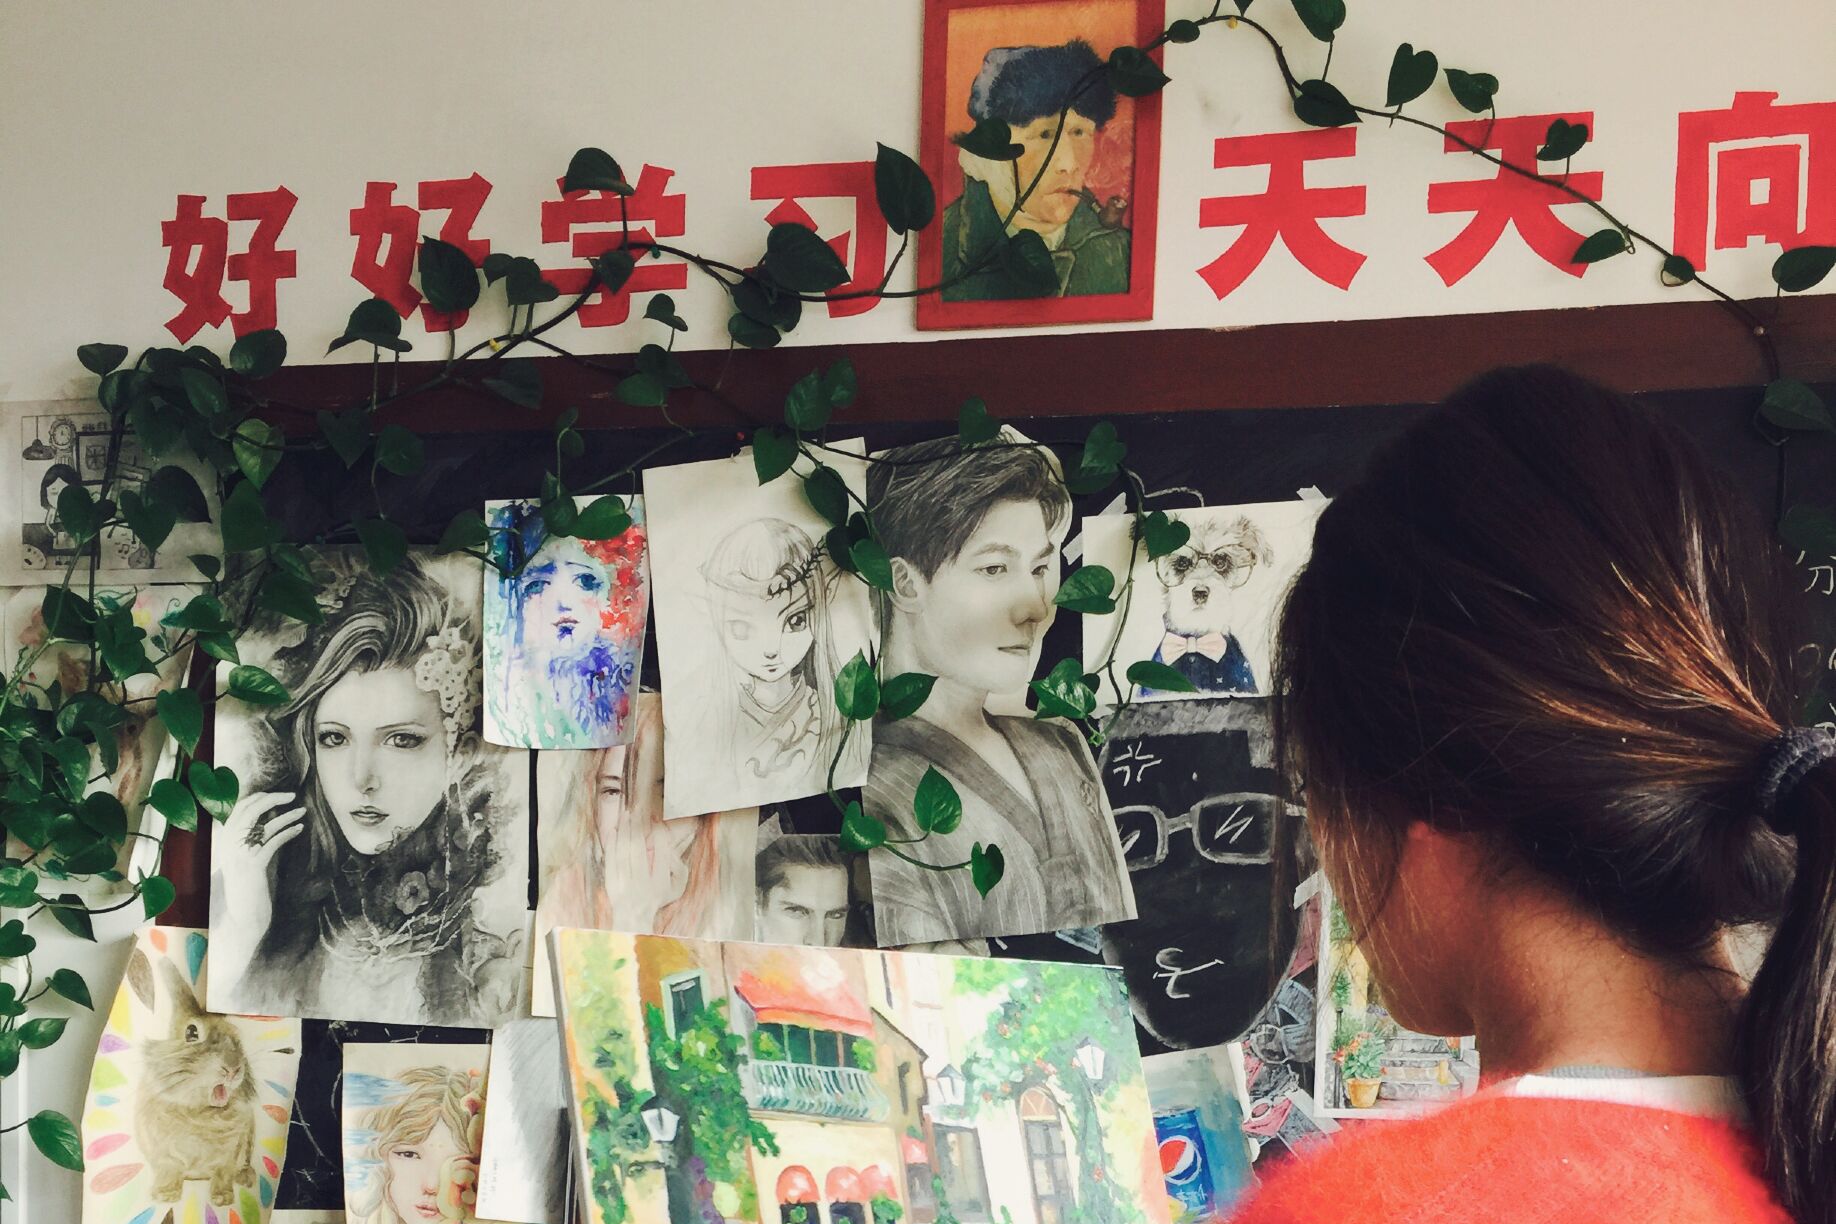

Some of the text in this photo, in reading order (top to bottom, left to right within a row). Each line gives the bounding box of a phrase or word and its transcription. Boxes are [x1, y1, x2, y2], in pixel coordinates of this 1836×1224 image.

[161, 91, 1836, 344] 好好学习 天天向
